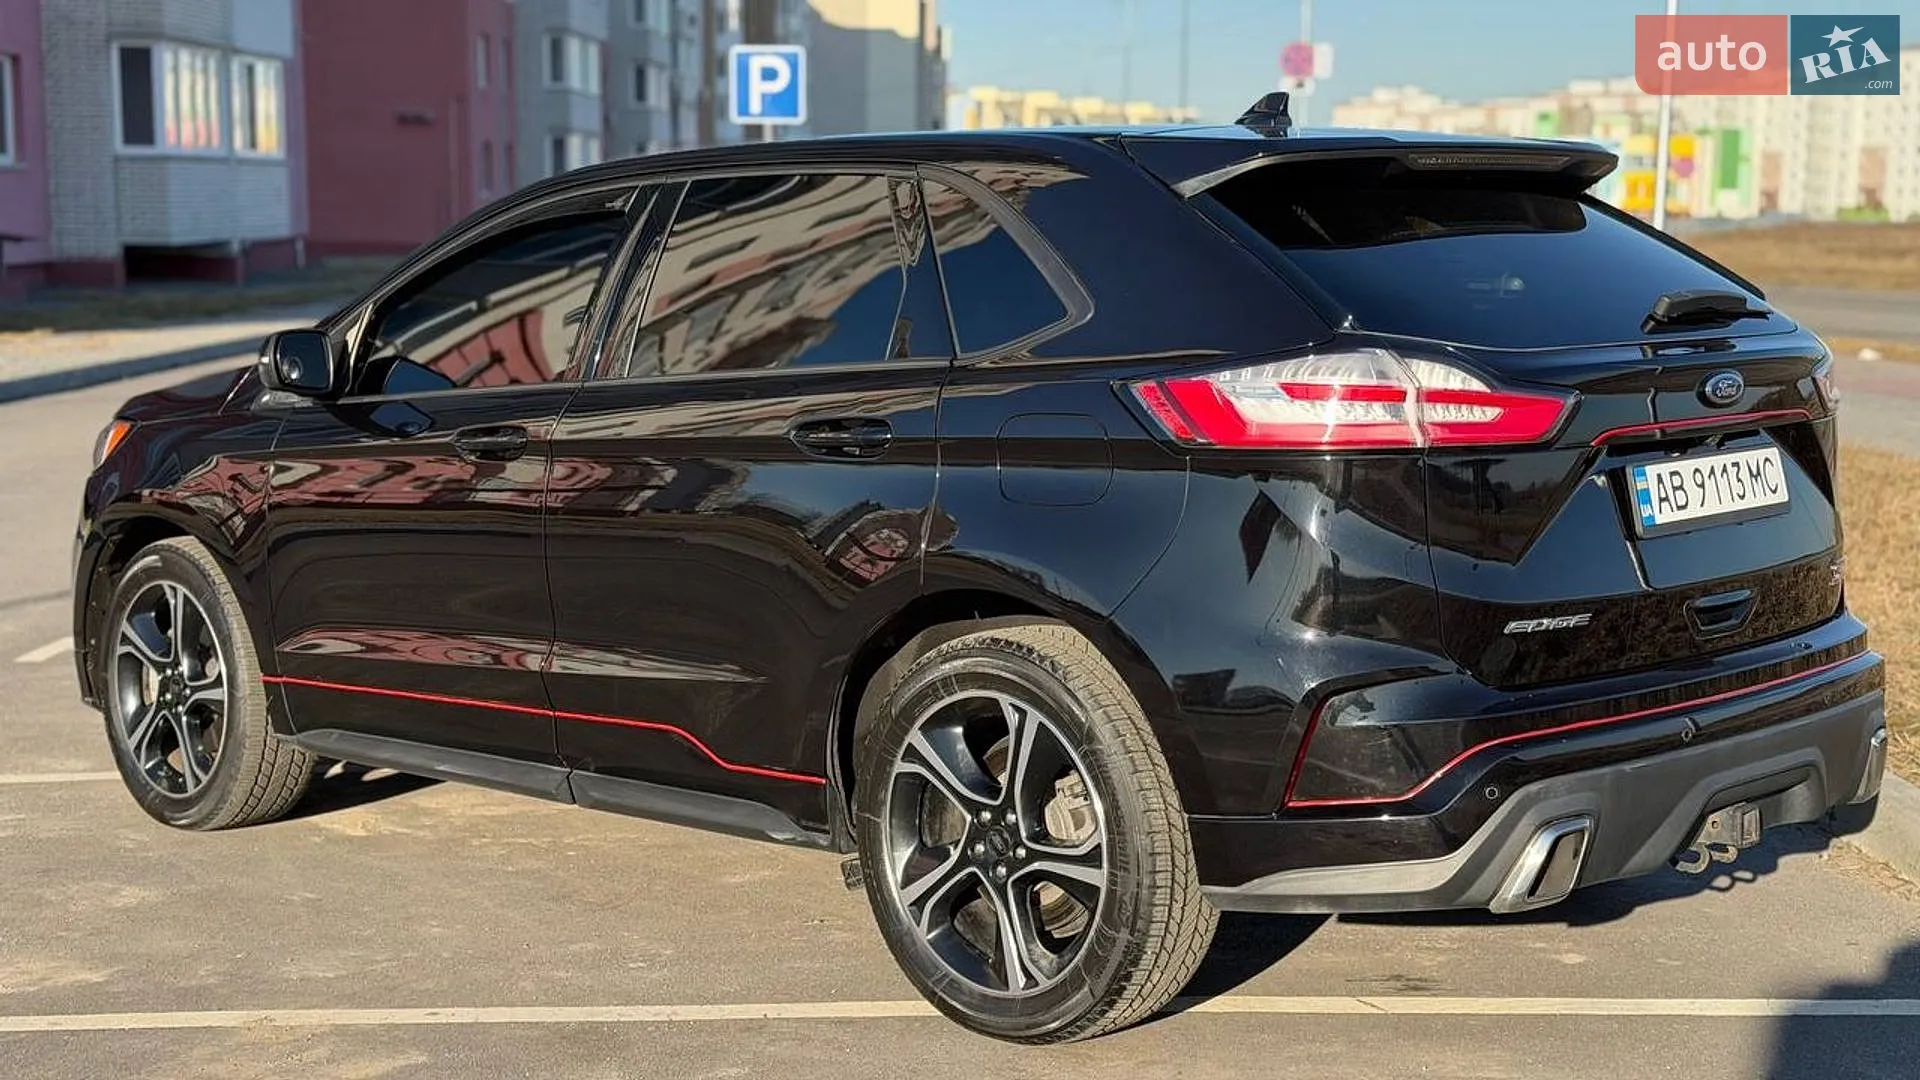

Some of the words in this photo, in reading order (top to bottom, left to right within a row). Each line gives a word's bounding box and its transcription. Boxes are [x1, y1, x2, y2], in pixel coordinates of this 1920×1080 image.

[748, 54, 792, 115] P
[1716, 379, 1738, 397] Ford
[1656, 470, 1689, 515] AB
[1692, 461, 1746, 507] 9113
[1746, 456, 1779, 498] MC
[1503, 613, 1592, 634] EDGE
